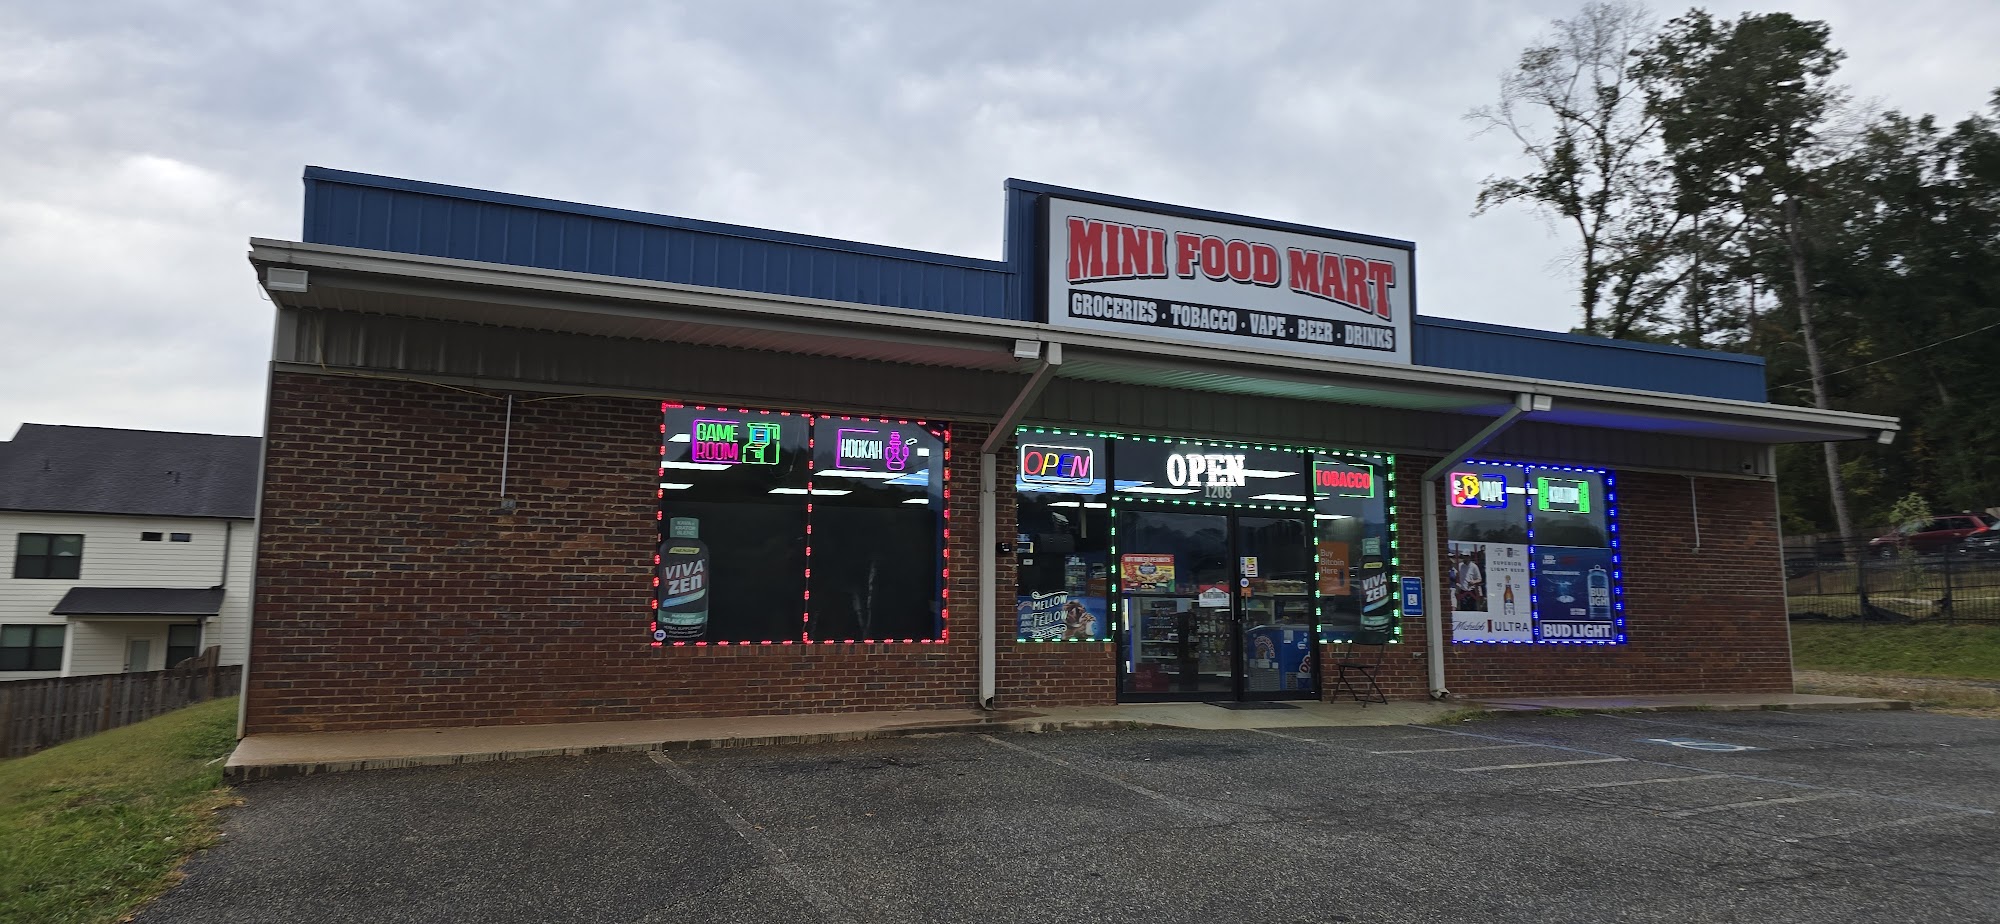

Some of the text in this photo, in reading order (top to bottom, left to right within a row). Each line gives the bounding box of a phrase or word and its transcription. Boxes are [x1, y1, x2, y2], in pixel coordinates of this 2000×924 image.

[1067, 216, 1396, 321] MINI FOOD MART
[1071, 292, 1393, 350] GROCERIES TOBACCO VAPE BEER DRINKS
[696, 423, 738, 443] GAME
[696, 442, 738, 461] ROOM
[841, 439, 883, 460] HOOKAH
[1024, 450, 1090, 478] OPEN
[1166, 453, 1246, 487] OPEN
[1316, 469, 1371, 489] TOBACCO
[1205, 485, 1232, 499] 1208
[1320, 549, 1333, 558] Buy
[1320, 558, 1345, 566] Bitcoin
[665, 560, 705, 580] VIVA
[1321, 567, 1338, 575] Here
[1362, 572, 1387, 590] VIVA
[1591, 588, 1607, 597] BUD
[1032, 594, 1068, 611] MELLOW
[1031, 610, 1069, 628] FELLOW
[1494, 621, 1530, 632] ULTRA
[1543, 623, 1611, 638] BUD LIGHT
